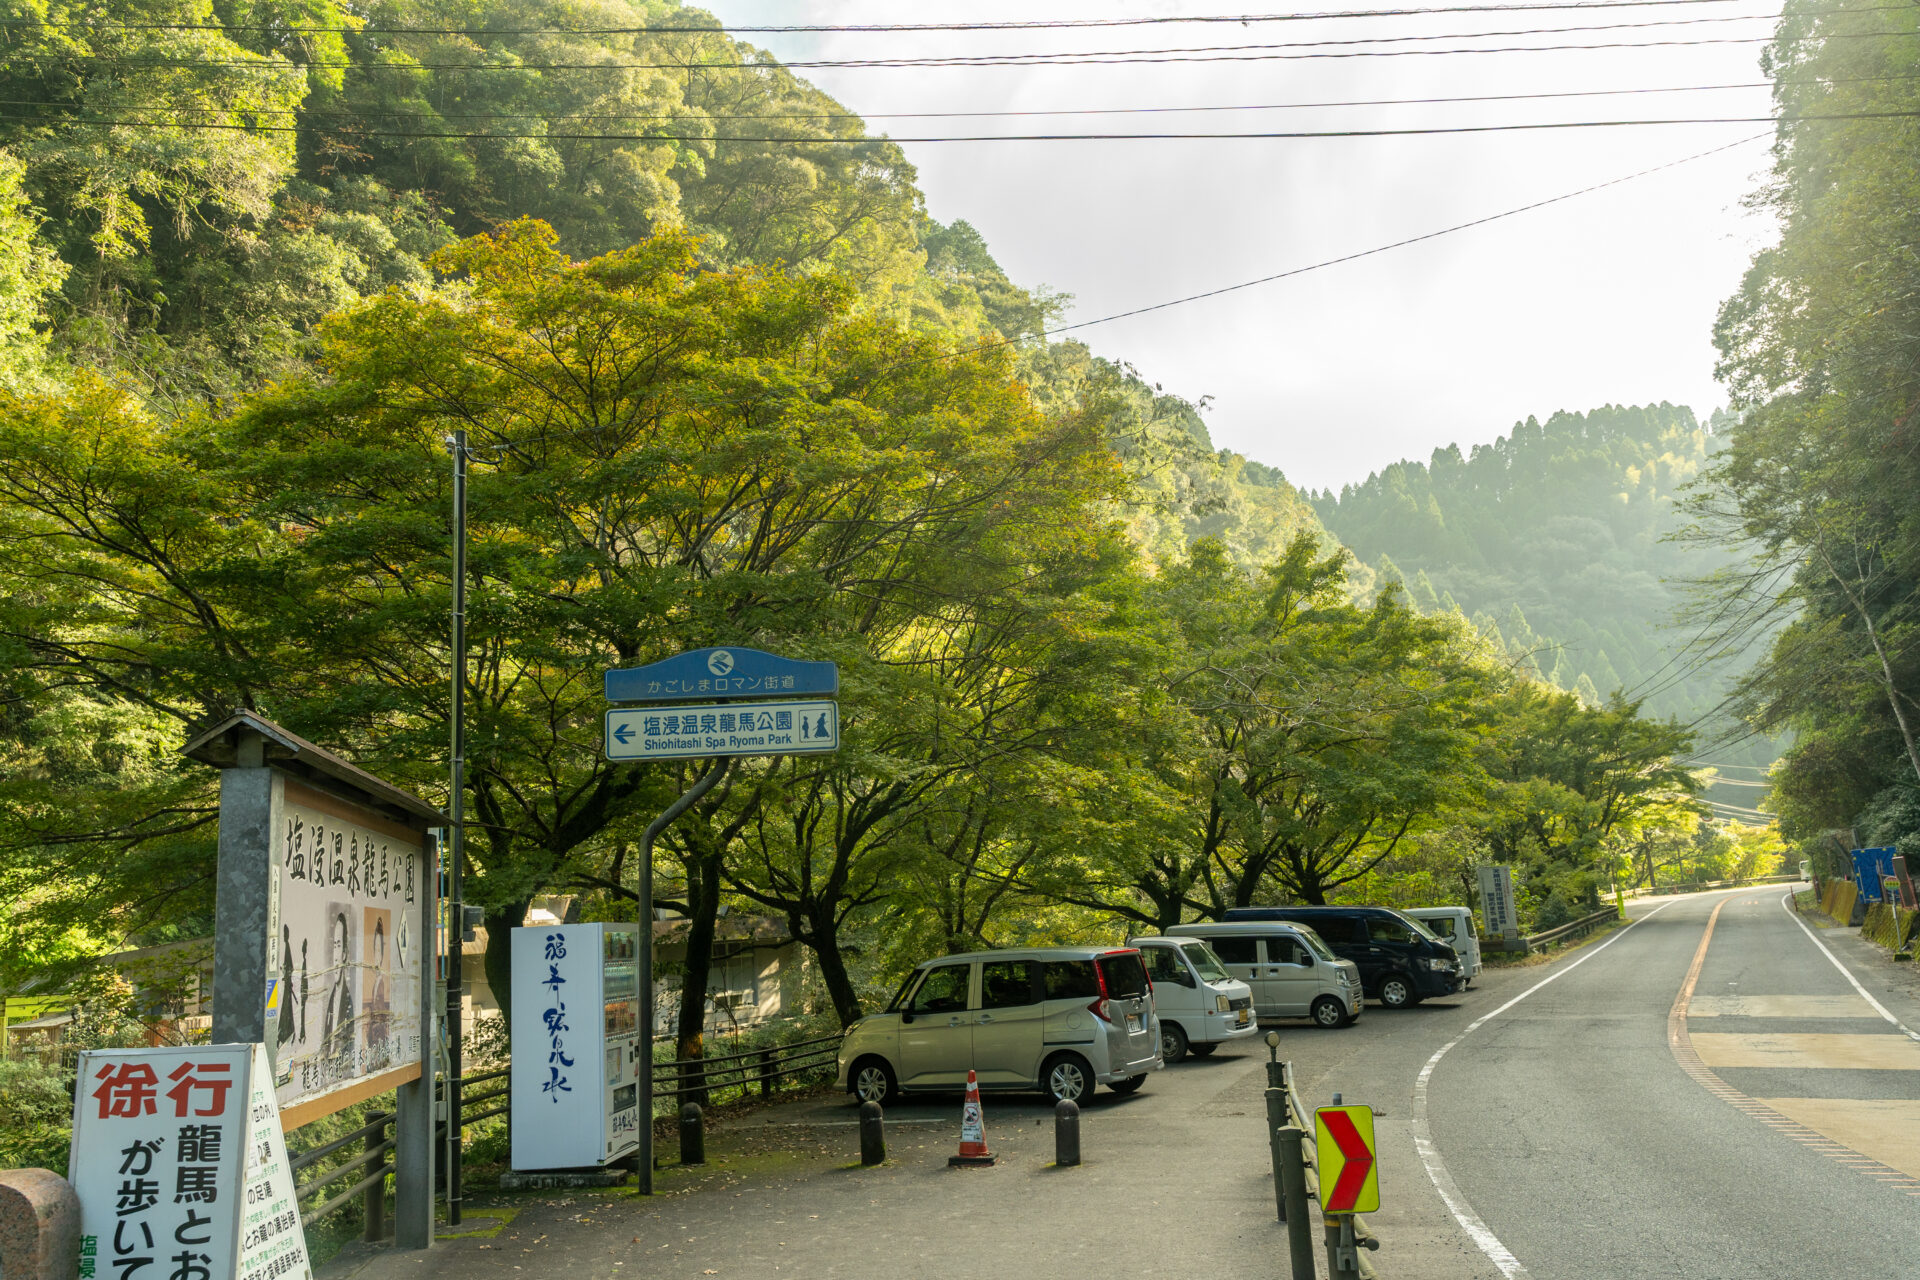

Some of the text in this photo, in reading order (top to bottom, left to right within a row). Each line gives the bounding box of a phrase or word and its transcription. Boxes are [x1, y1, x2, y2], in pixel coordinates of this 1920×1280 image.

[648, 675, 795, 694] かごしまロマン街道
[643, 711, 792, 736] 塩浸温泉龍馬公園
[644, 733, 792, 750] Shiohitashi Spa Ryoma Park
[285, 814, 415, 906] 塩浸温泉龍馬公園
[92, 1061, 233, 1119] 徐行
[111, 1136, 166, 1280] が歩いて
[169, 1124, 223, 1280] 龍馬とお
